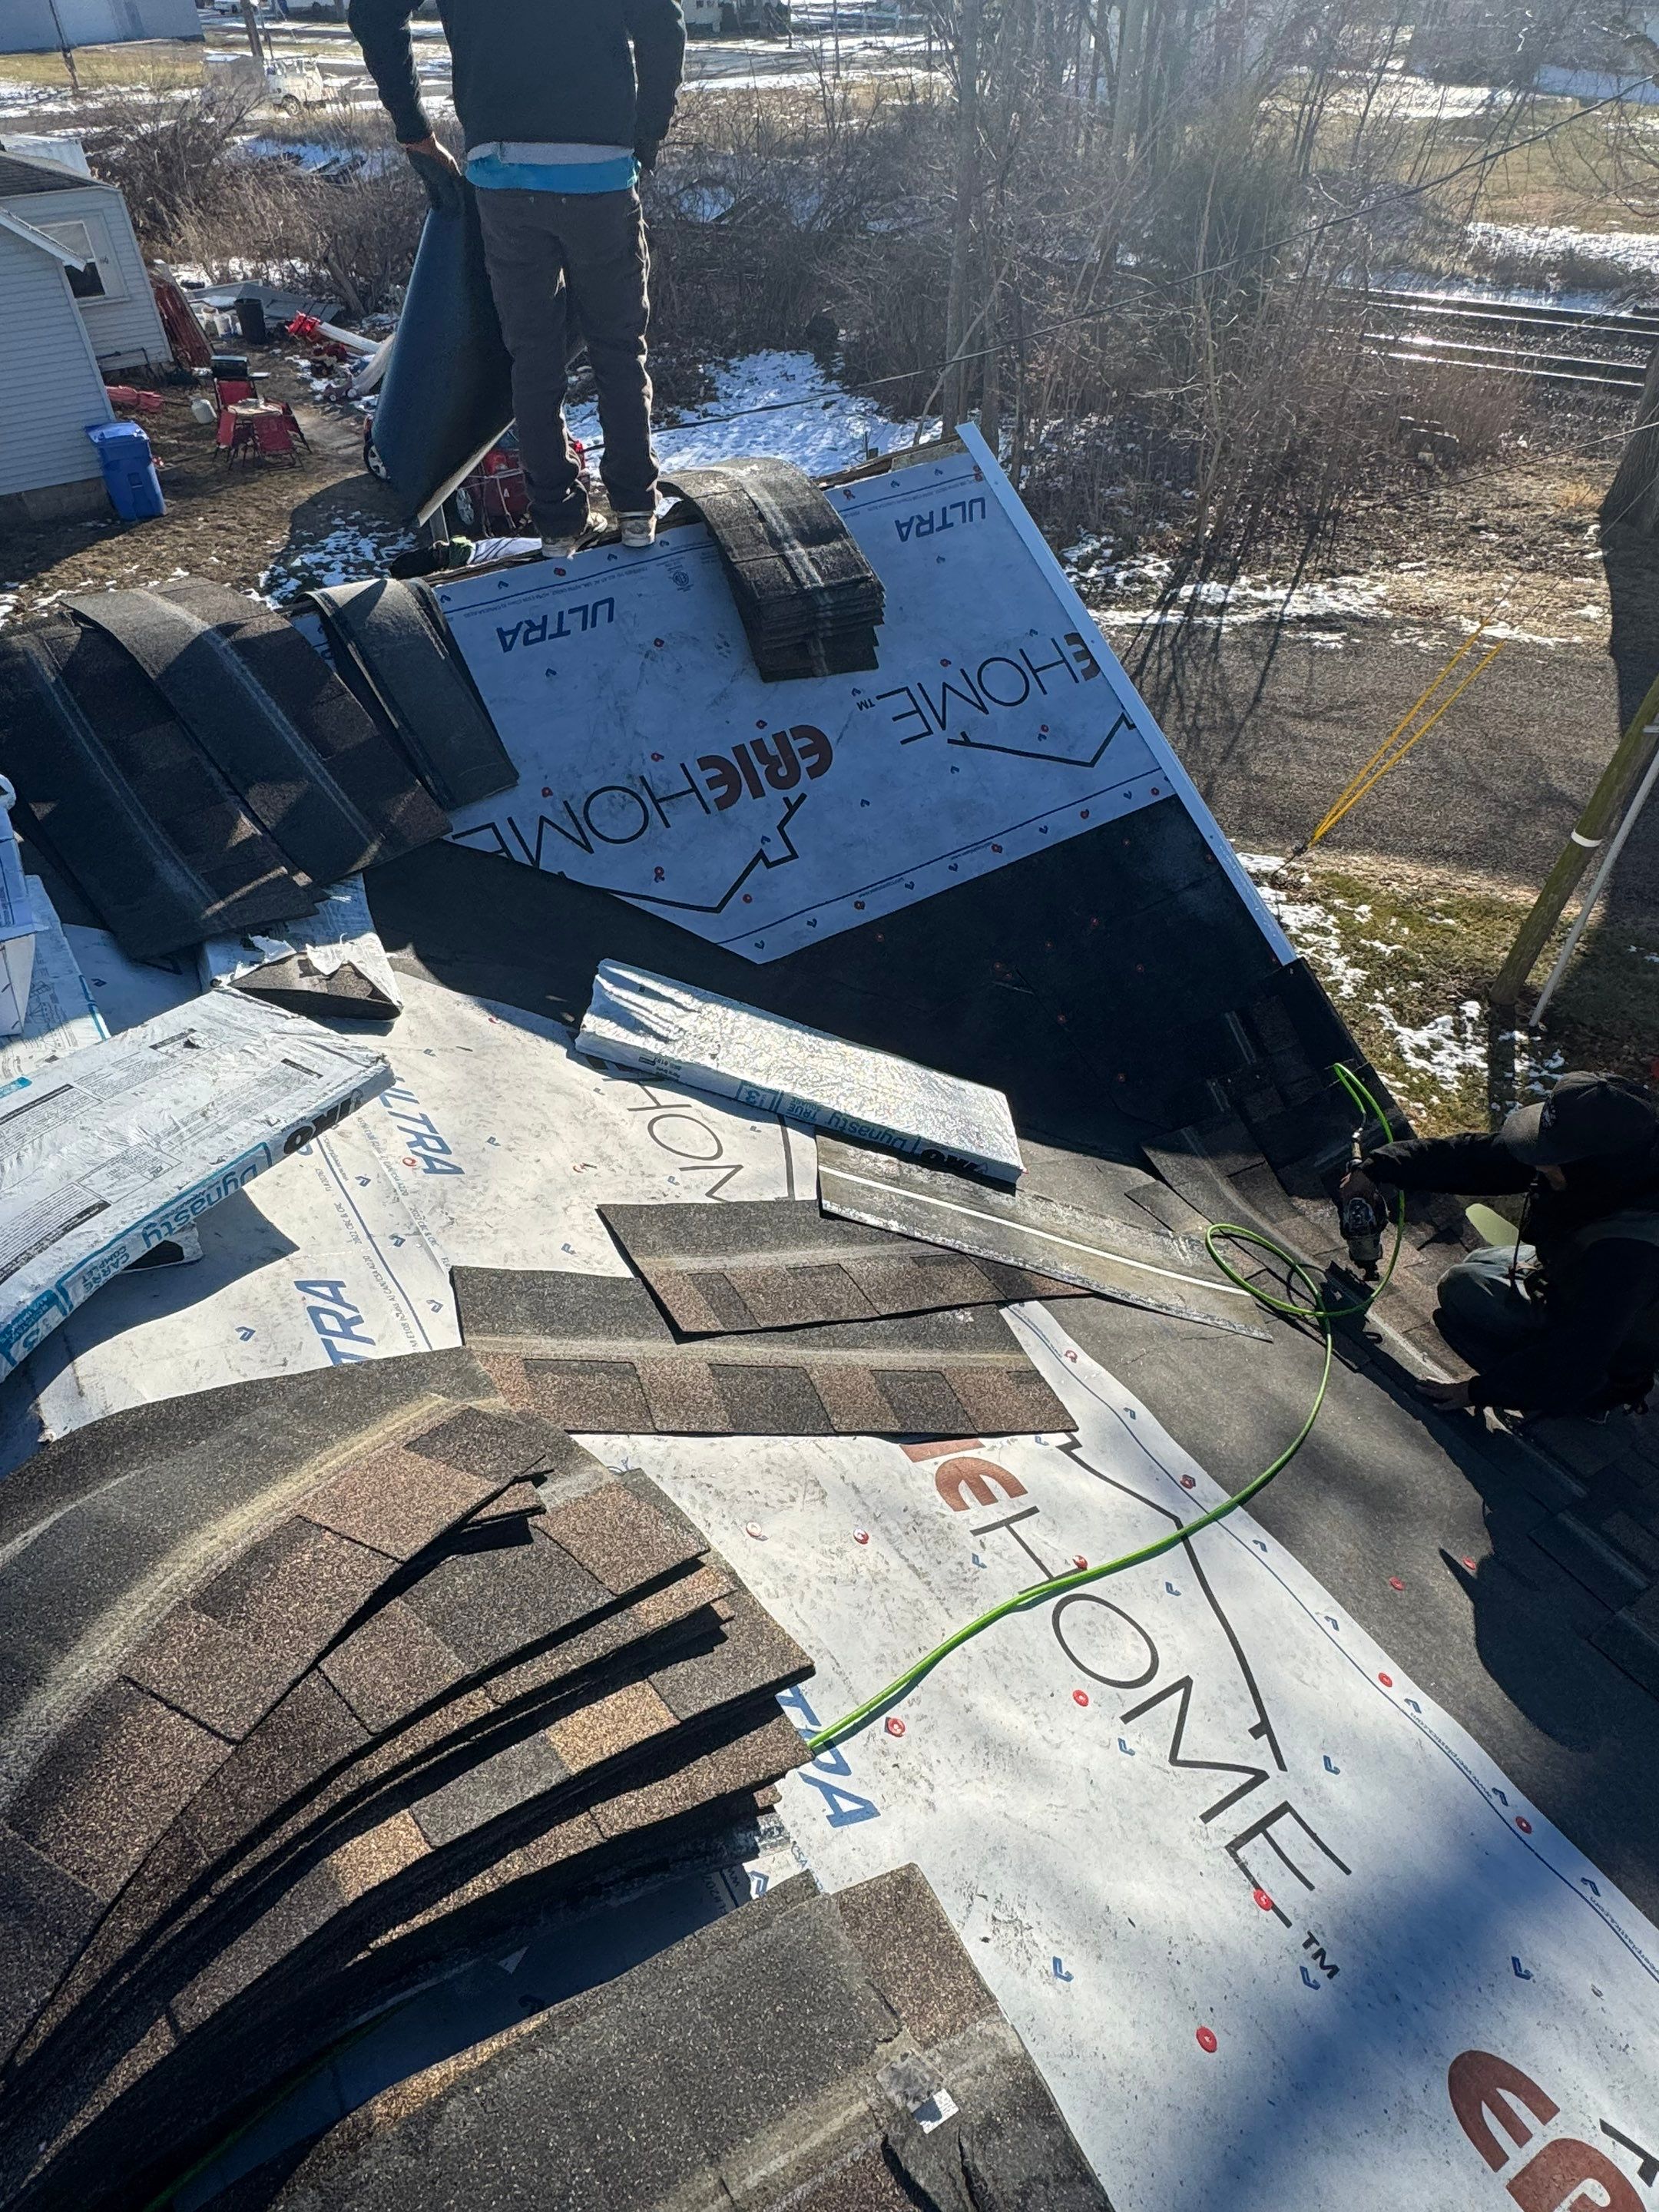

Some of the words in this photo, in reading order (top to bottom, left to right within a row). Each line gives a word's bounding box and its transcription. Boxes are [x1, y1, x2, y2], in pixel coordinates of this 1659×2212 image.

[894, 496, 986, 542] ULTRA
[496, 596, 615, 653] ULTRA
[601, 1078, 743, 1203] HOM
[786, 1101, 820, 1122] TRUE
[141, 1163, 258, 1249] Dynasty
[293, 1280, 375, 1366] TRA
[775, 1684, 881, 1828] TRA
